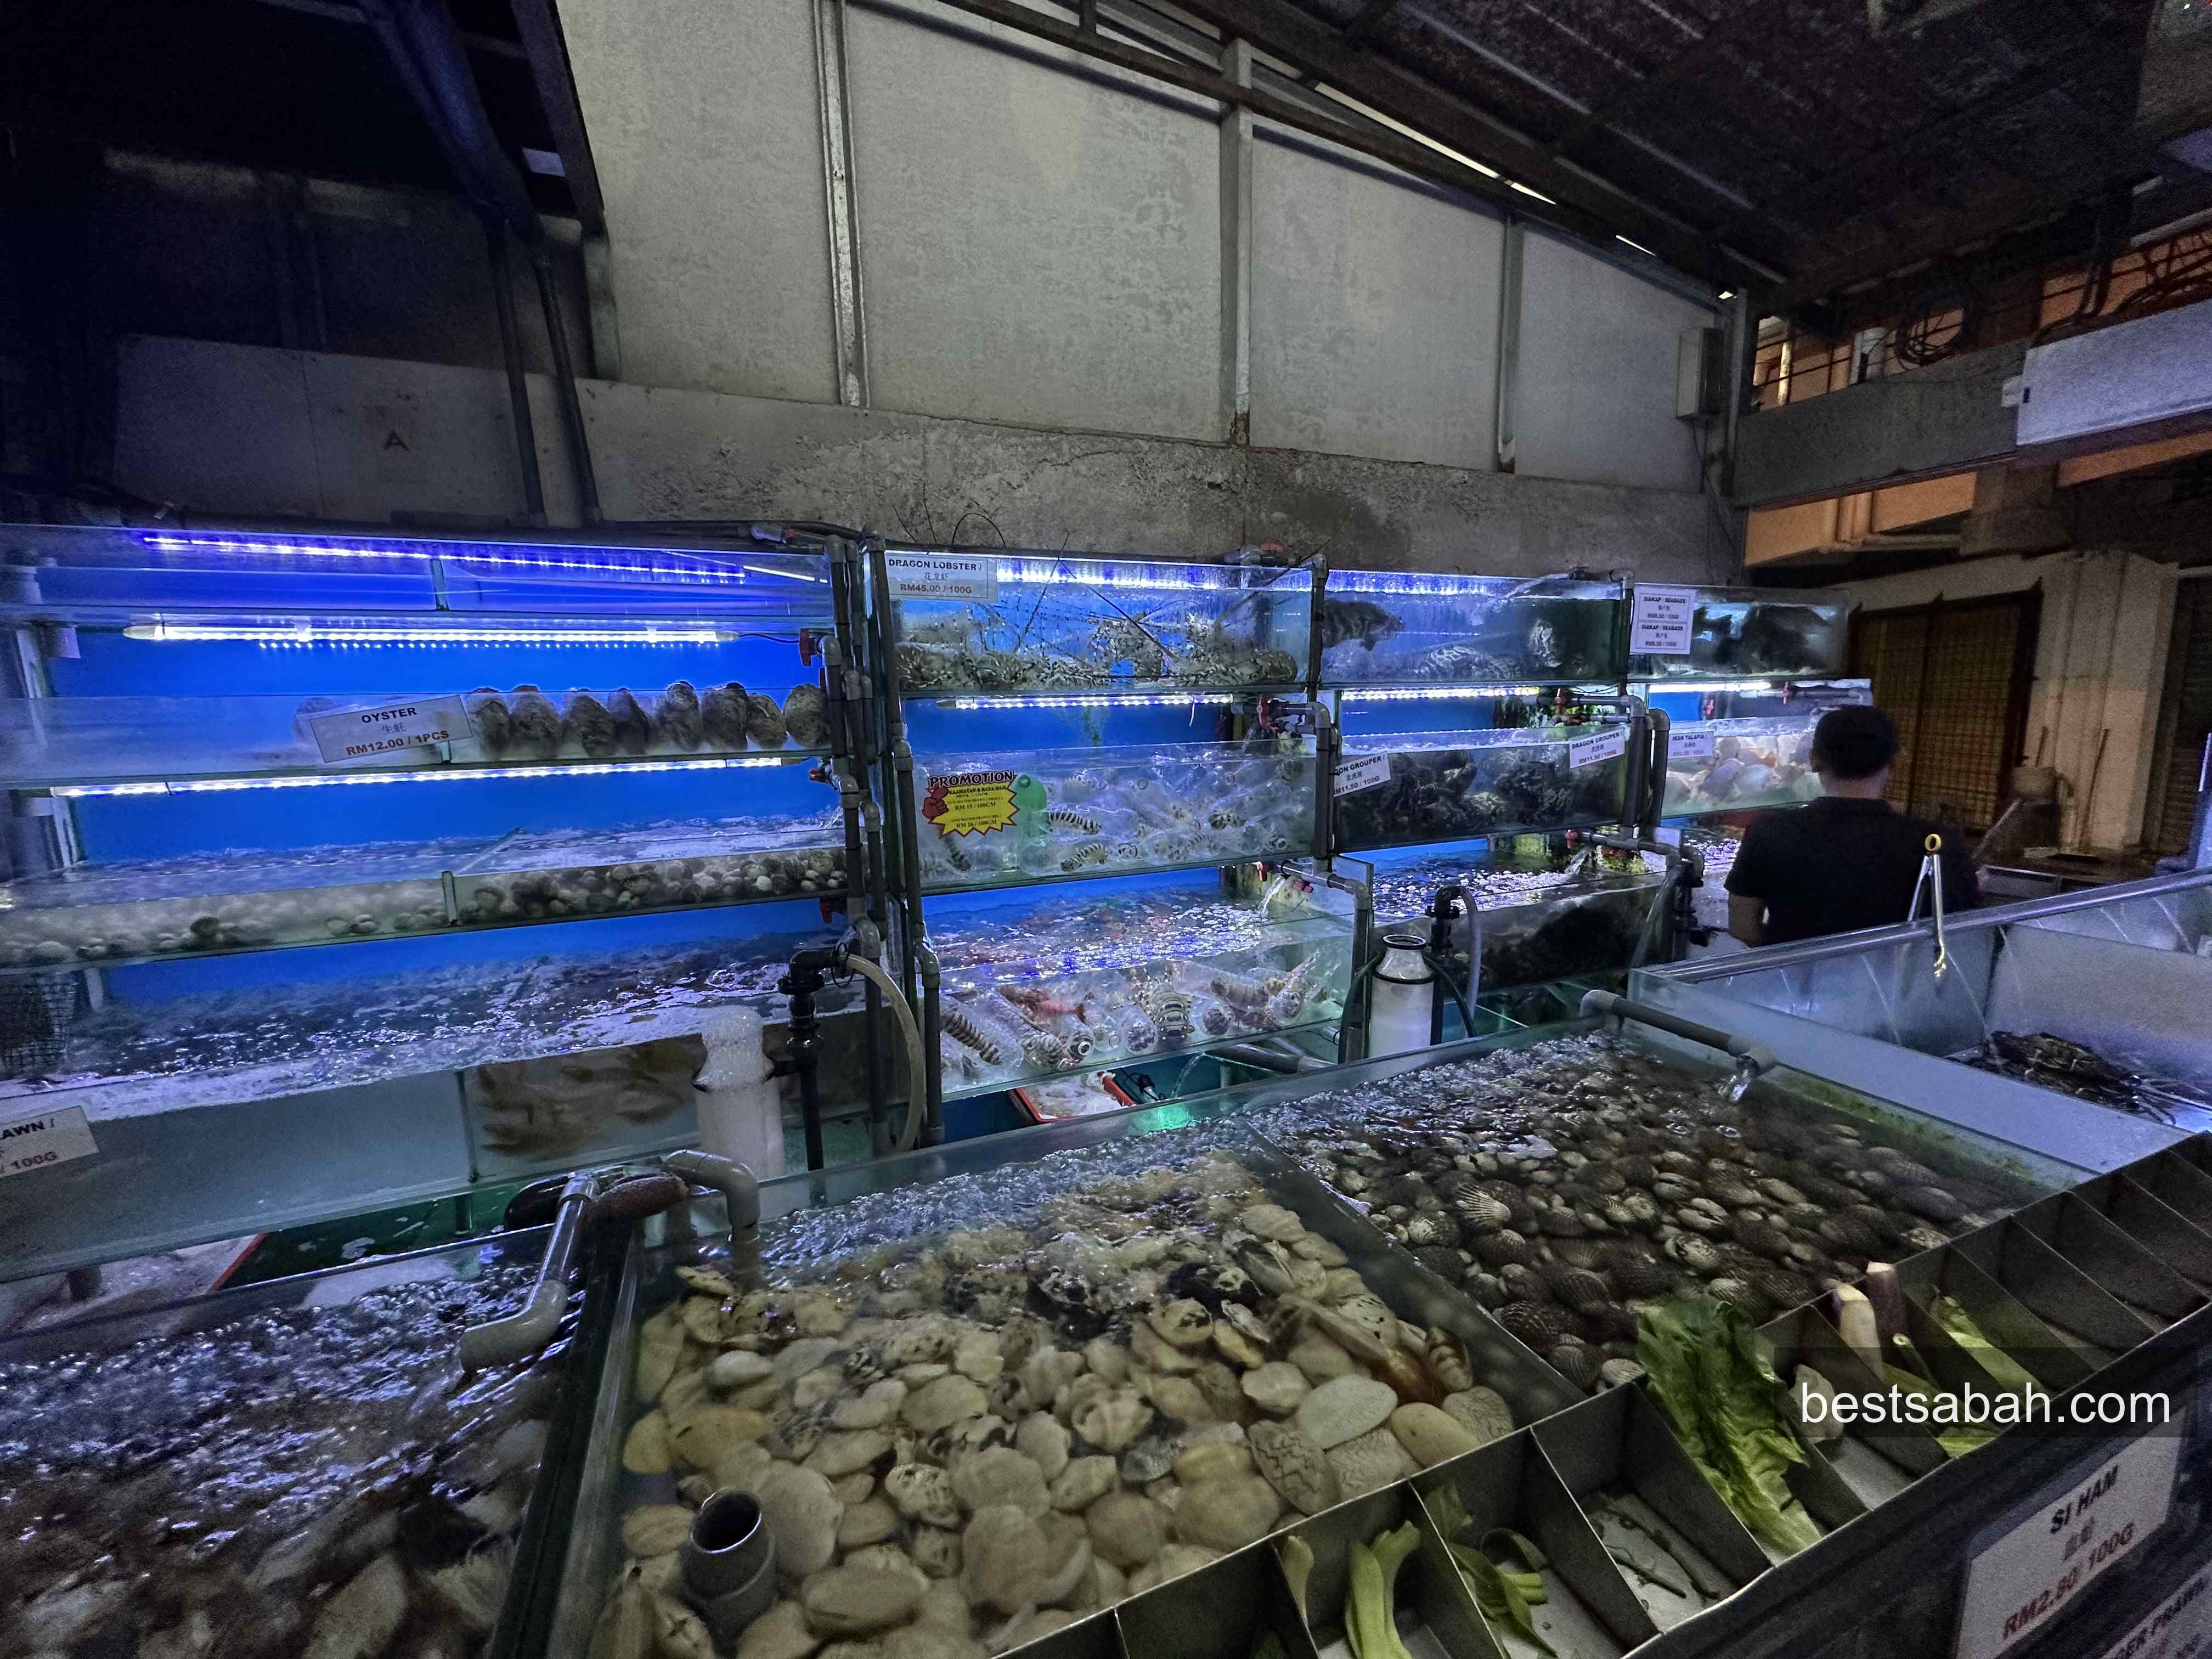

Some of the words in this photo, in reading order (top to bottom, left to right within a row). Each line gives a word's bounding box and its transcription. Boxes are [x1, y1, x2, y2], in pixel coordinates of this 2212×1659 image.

[889, 559, 930, 568] DRAGON
[933, 561, 977, 571] LOBSTER
[900, 584, 940, 592] RM45.00
[949, 585, 972, 594] 100G
[362, 707, 417, 724] OYSTER
[346, 738, 404, 755] RM12.00
[415, 730, 449, 744] 1PCS
[1572, 739, 1594, 749] DRAGON
[1595, 732, 1620, 743] GROUPER
[1350, 756, 1381, 770] GROUPER
[1579, 754, 1600, 764] RM11.50
[929, 770, 1013, 788] PROMOTION
[1364, 776, 1379, 785] 100G
[0, 1121, 46, 1139] AWN
[10, 1151, 57, 1169] 100G
[2050, 1502, 2072, 1534] SI
[2076, 1464, 2119, 1517] HAM
[2089, 1521, 2134, 1571] 100G
